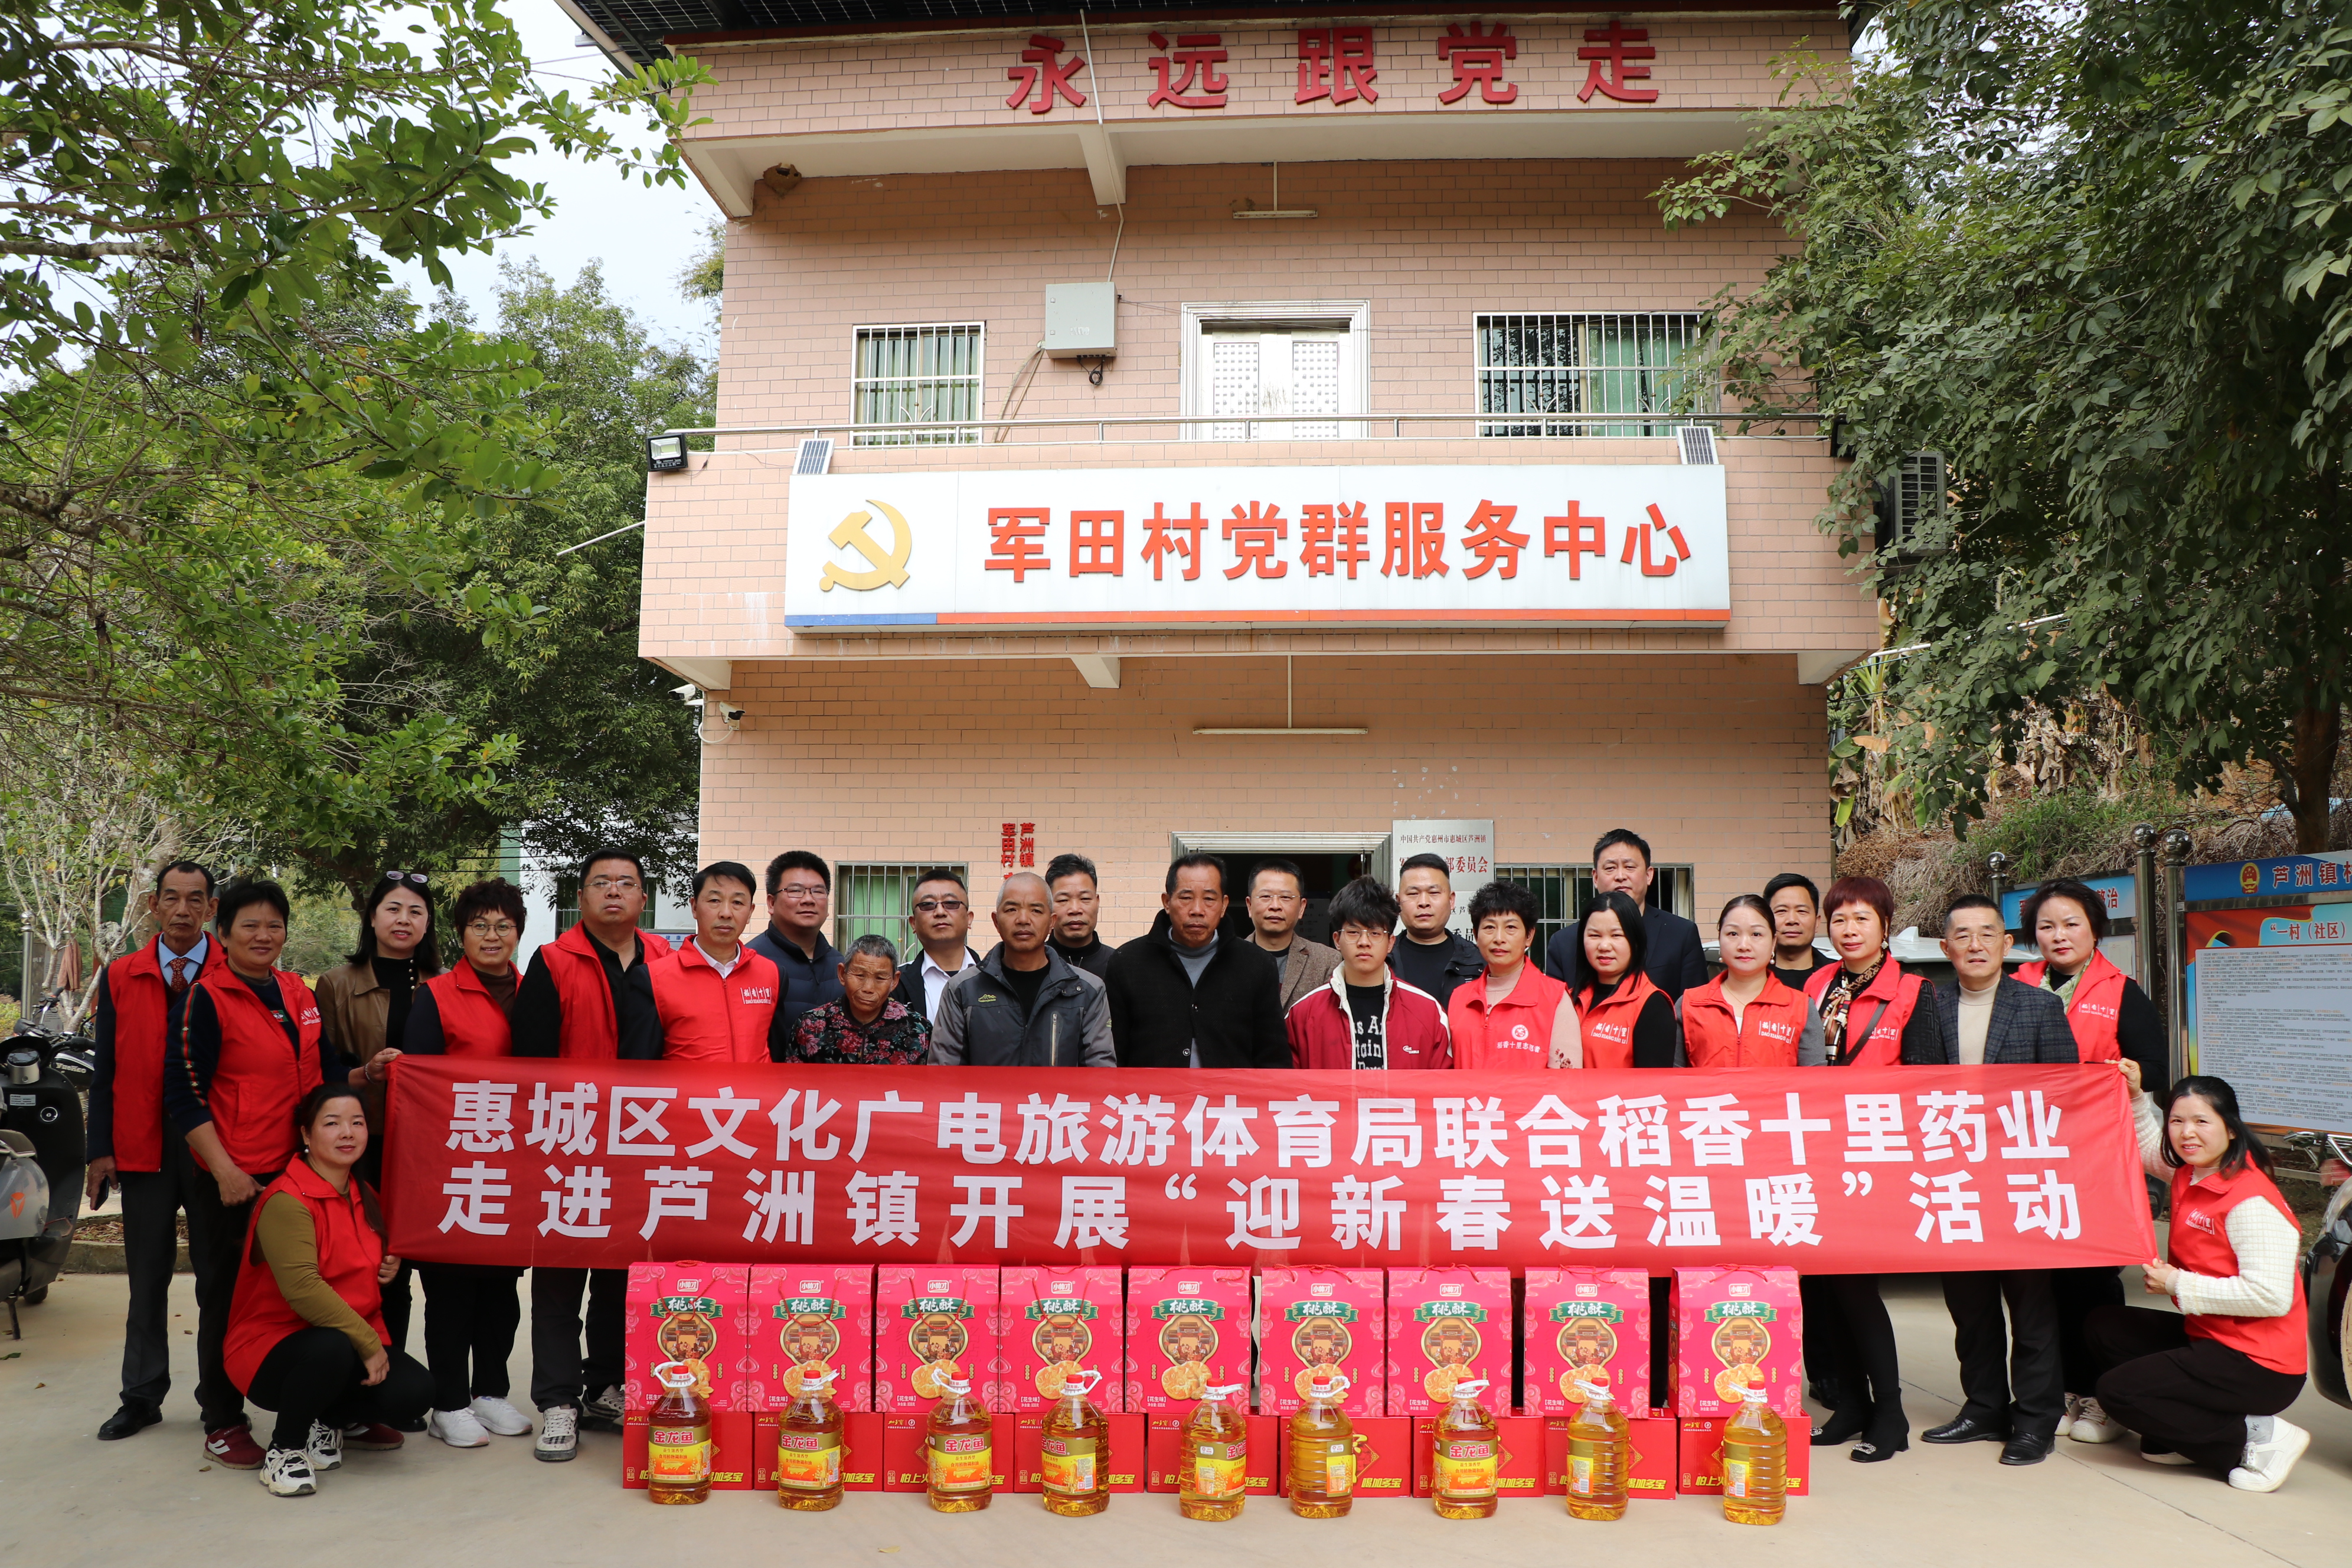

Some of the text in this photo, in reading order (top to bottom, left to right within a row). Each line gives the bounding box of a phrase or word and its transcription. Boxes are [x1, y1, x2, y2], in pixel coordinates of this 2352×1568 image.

[1007, 21, 1659, 114] 永远跟党走
[985, 499, 1692, 582] 军田村党群服务中心
[1020, 822, 1035, 867] 芦洲镇
[1400, 834, 1487, 844] 中国共产党惠州市惠城区芦洲镇
[1497, 1041, 1540, 1053] 稻香十里志愿者
[446, 1080, 2071, 1170] 惠城区文化广电旅游体育局联合稻香十里药业
[437, 1160, 2080, 1251] 走进芦洲镇开展“迎新春送温暖”活动
[1577, 1285, 1595, 1293] 小帅才
[790, 1298, 829, 1312] 桃酥
[919, 1298, 958, 1312] 桃酥
[1043, 1299, 1081, 1314] 桃酥
[1170, 1300, 1208, 1314] 桃酥
[1302, 1302, 1342, 1316] 桃酥
[1432, 1302, 1471, 1316] 桃酥
[1567, 1302, 1607, 1316] 桃酥
[1722, 1302, 1760, 1316] 桃酥
[654, 1430, 693, 1443] 金龙鱼
[782, 1435, 818, 1450] 金龙鱼
[945, 1437, 985, 1452] 金龙鱼
[1449, 1444, 1490, 1458] 金龙鱼
[842, 1472, 875, 1483] 加多宝
[1030, 1472, 1043, 1482] 怕
[1361, 1477, 1402, 1488] 喝加多宝
